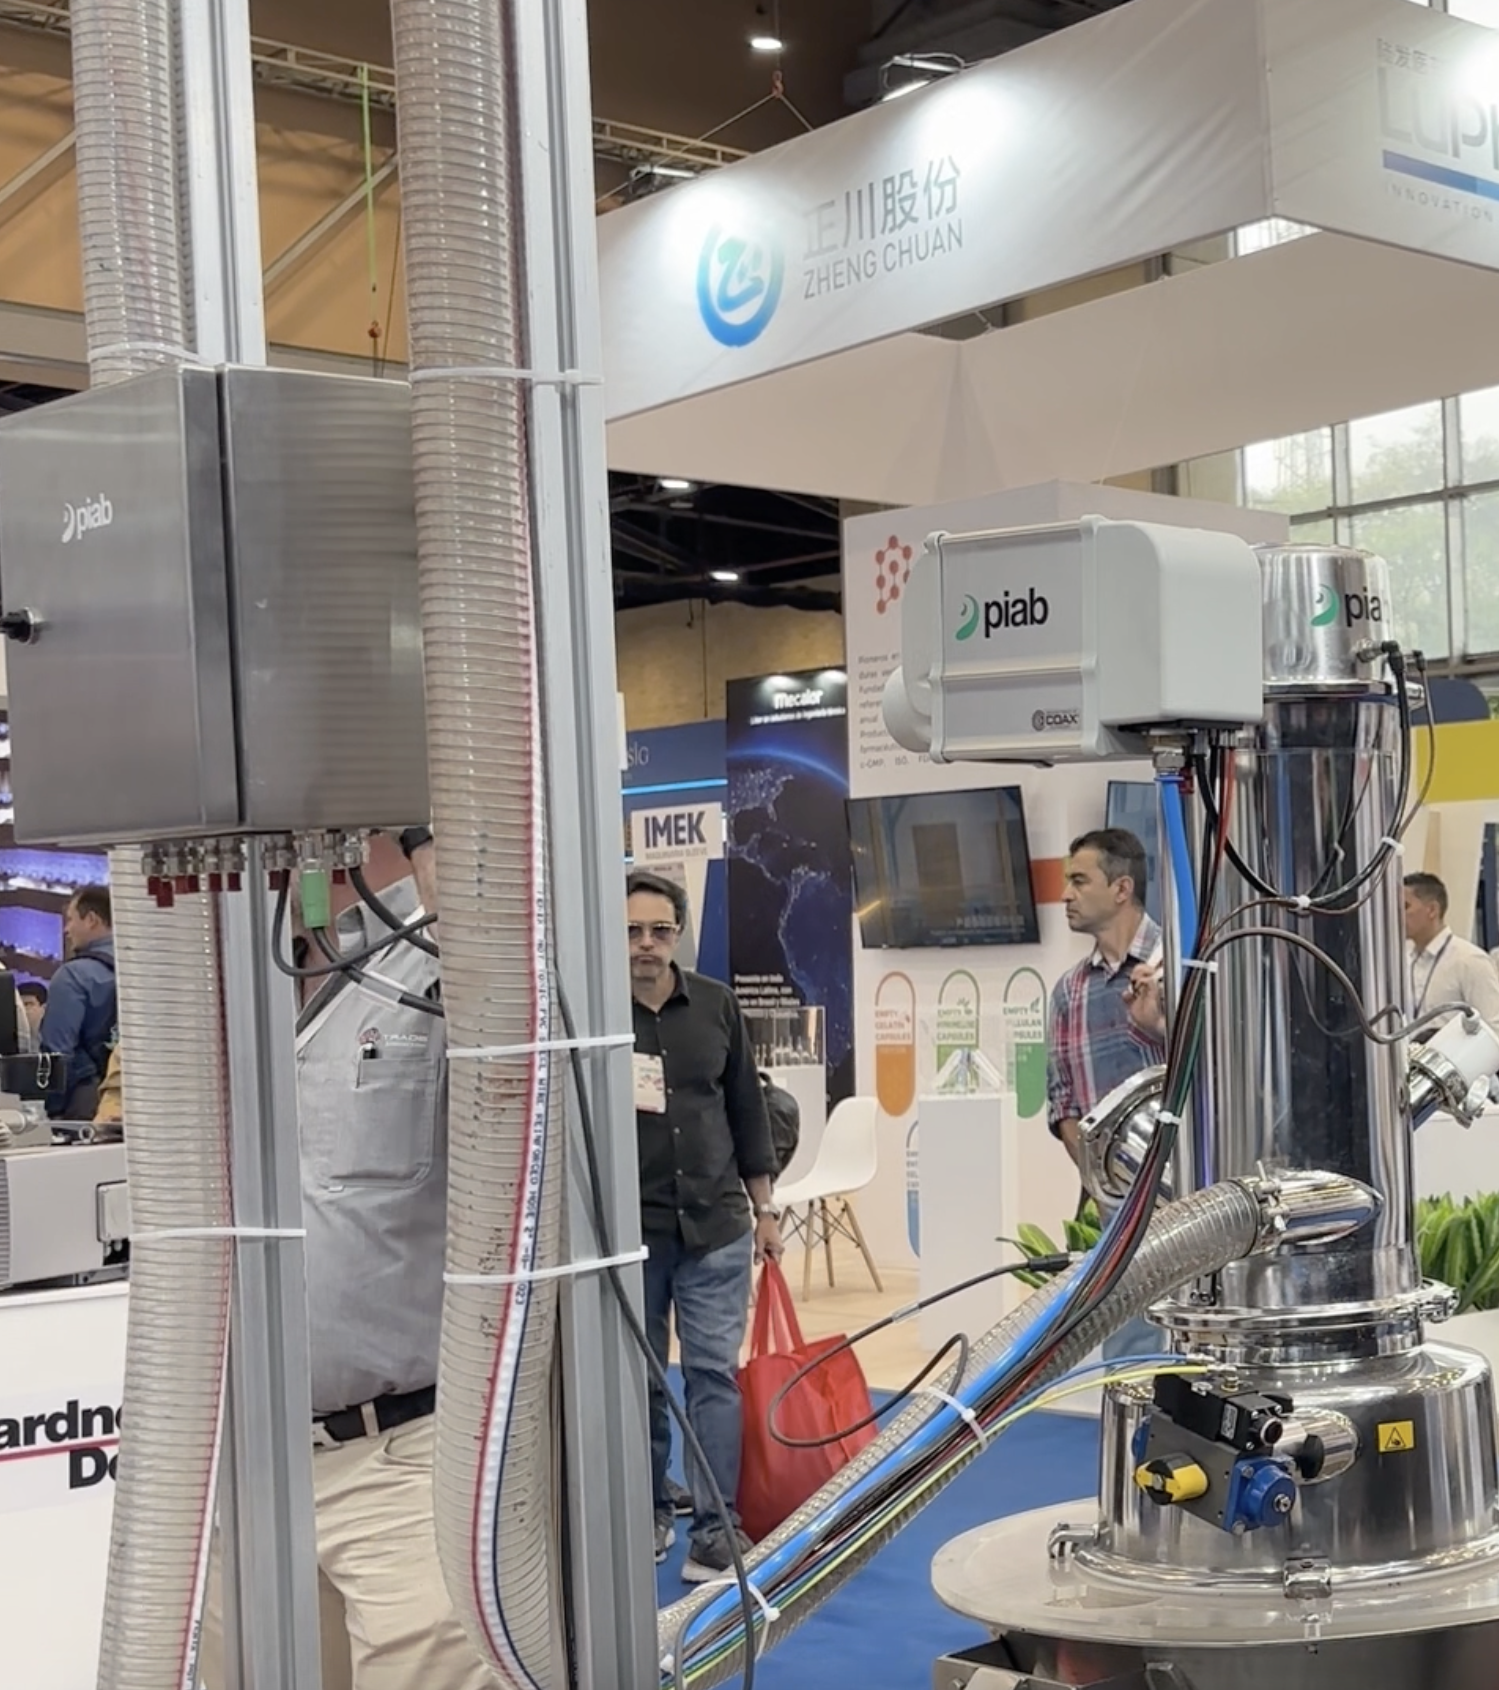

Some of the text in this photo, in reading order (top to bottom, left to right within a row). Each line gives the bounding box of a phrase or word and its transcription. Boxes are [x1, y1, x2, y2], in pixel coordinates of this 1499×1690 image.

[802, 155, 961, 261] 正川股份
[1385, 182, 1494, 223] INNOVATION
[803, 218, 963, 300] ZHENG CHUAN
[76, 492, 113, 541] piab
[984, 587, 1049, 639] piab
[1046, 713, 1079, 726] COAX
[644, 810, 706, 849] IMEK
[538, 1035, 548, 1071] SEEL
